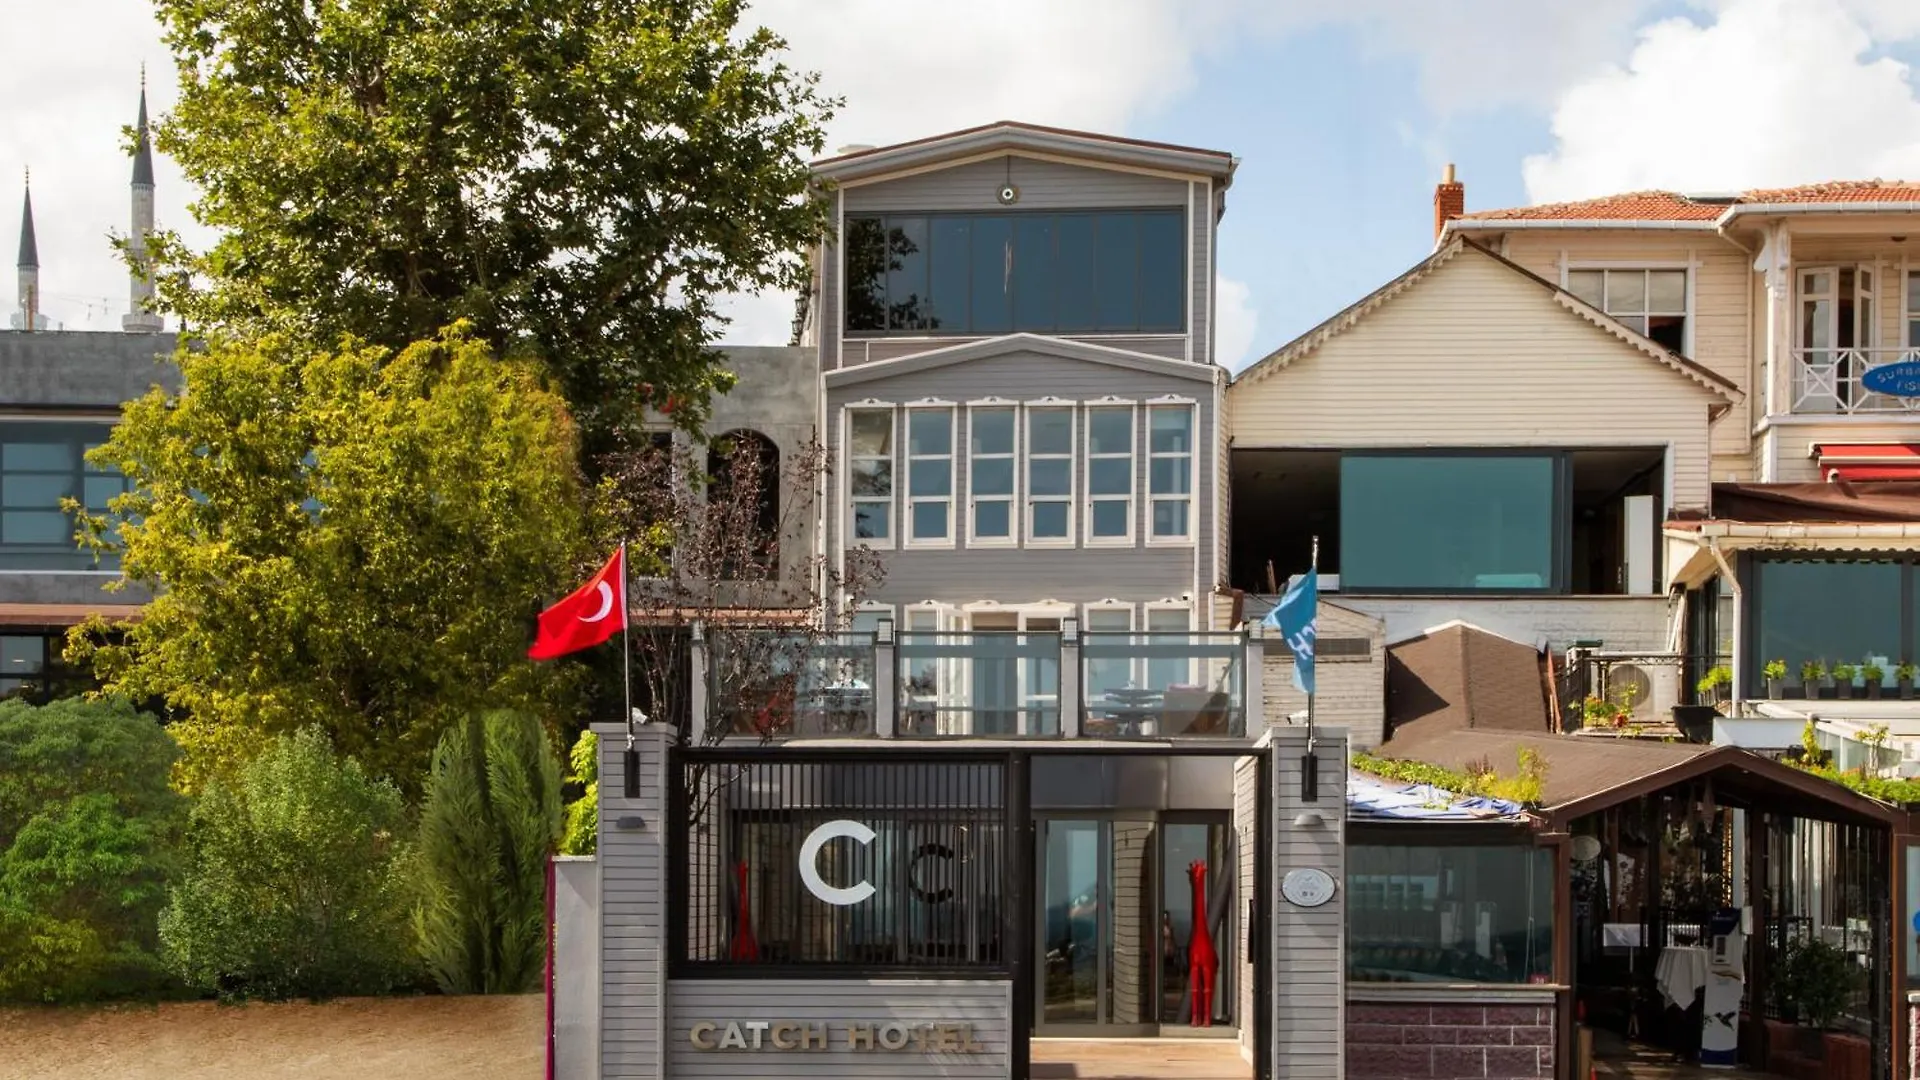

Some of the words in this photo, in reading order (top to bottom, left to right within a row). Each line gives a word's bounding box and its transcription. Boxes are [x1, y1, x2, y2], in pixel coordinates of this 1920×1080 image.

[799, 819, 876, 906] C
[690, 1021, 827, 1050] CATCH
[848, 1022, 983, 1052] HOTEL
